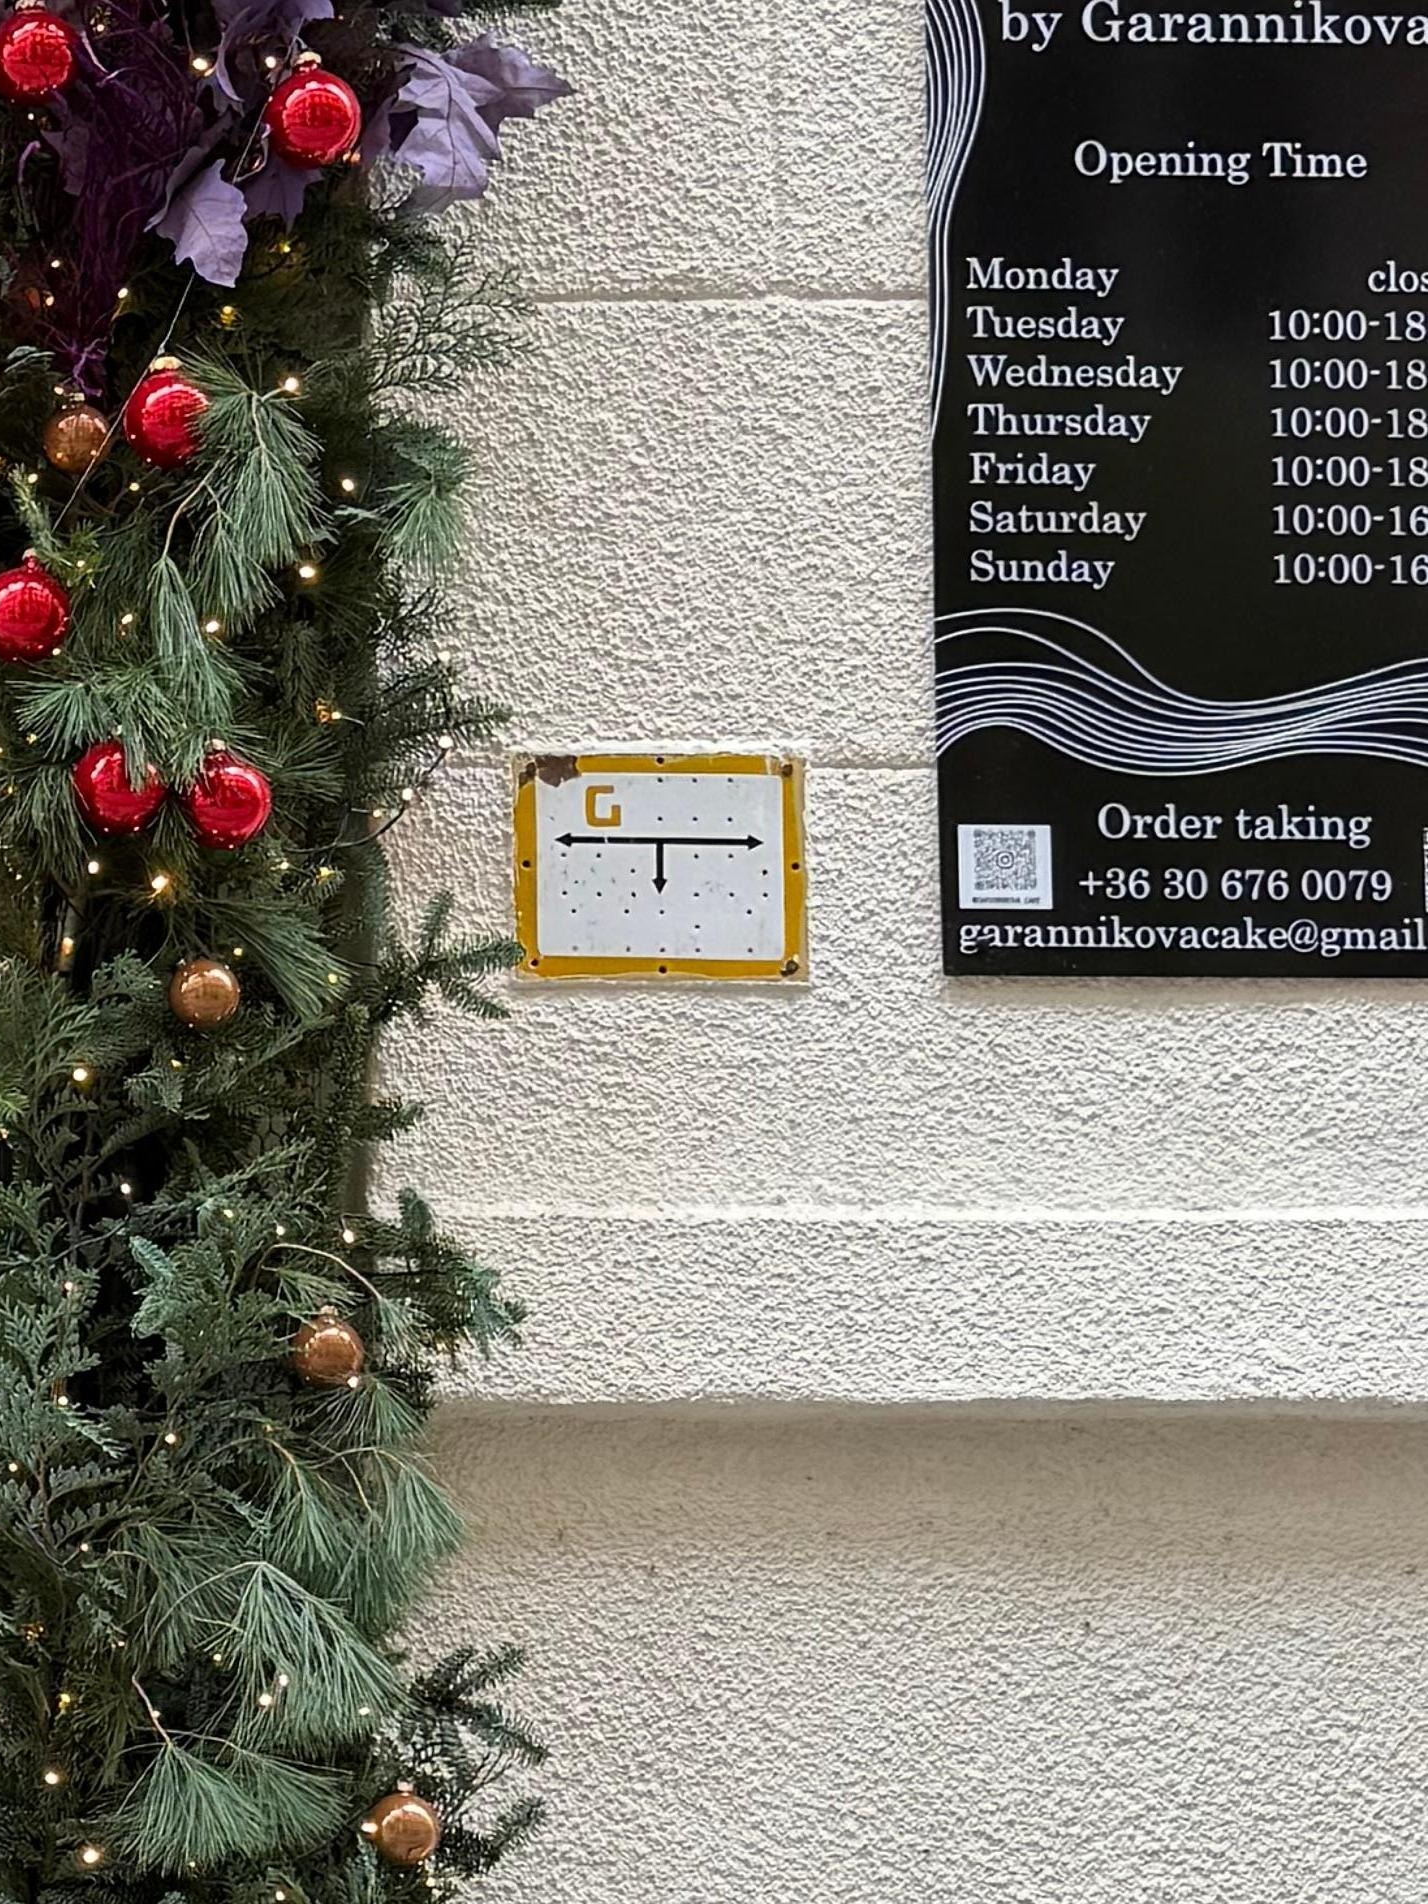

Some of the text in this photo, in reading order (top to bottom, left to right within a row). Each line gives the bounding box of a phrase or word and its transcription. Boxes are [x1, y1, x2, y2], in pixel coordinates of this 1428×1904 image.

[1074, 140, 1368, 186] Opening Time
[965, 257, 1120, 298] Monday
[966, 305, 1125, 346] Tuesday
[966, 354, 1428, 396] Wednesday 10:00-18
[967, 403, 1428, 444] Thursday 10:00-18
[969, 452, 1428, 492] Friday 10:00-18
[969, 500, 1428, 542] Saturday 10:00-16
[970, 549, 1428, 590] Sunday 10:00-16
[1097, 802, 1373, 849] Order taking
[1078, 867, 1393, 901] +36 30 676 0079
[959, 915, 1428, 958] garannikovacake@gmail
